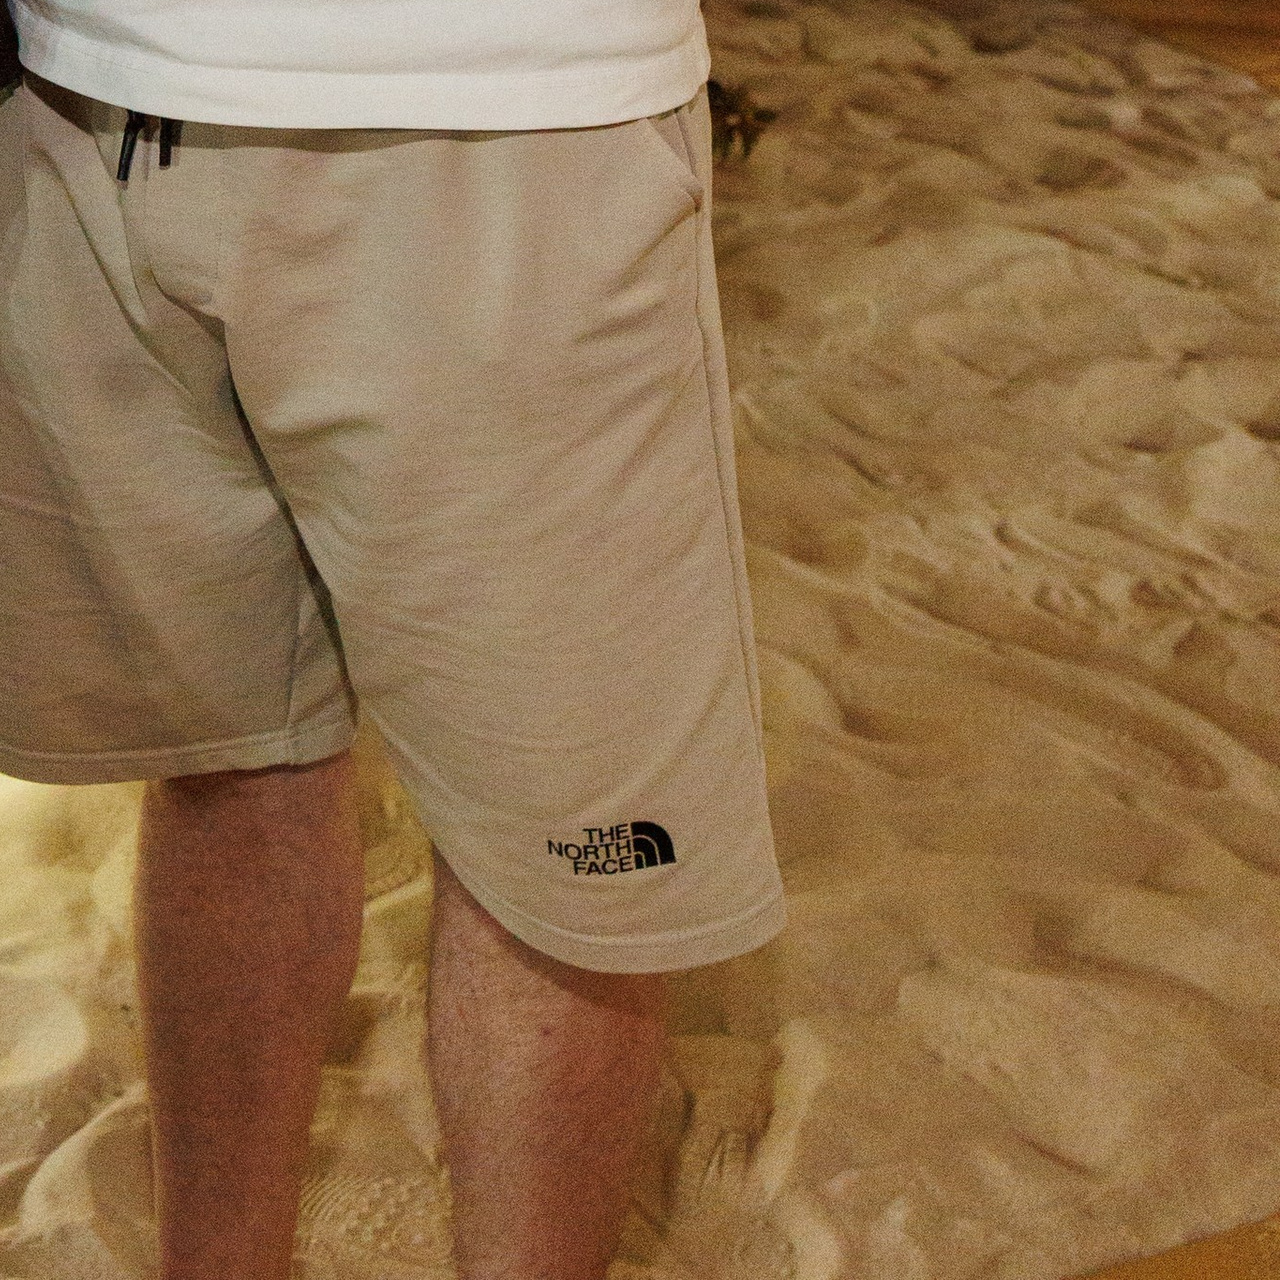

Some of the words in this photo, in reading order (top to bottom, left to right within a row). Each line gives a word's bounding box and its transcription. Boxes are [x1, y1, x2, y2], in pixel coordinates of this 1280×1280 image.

[582, 823, 630, 844] THE
[547, 839, 632, 860] NORTH
[573, 855, 634, 876] FACE
